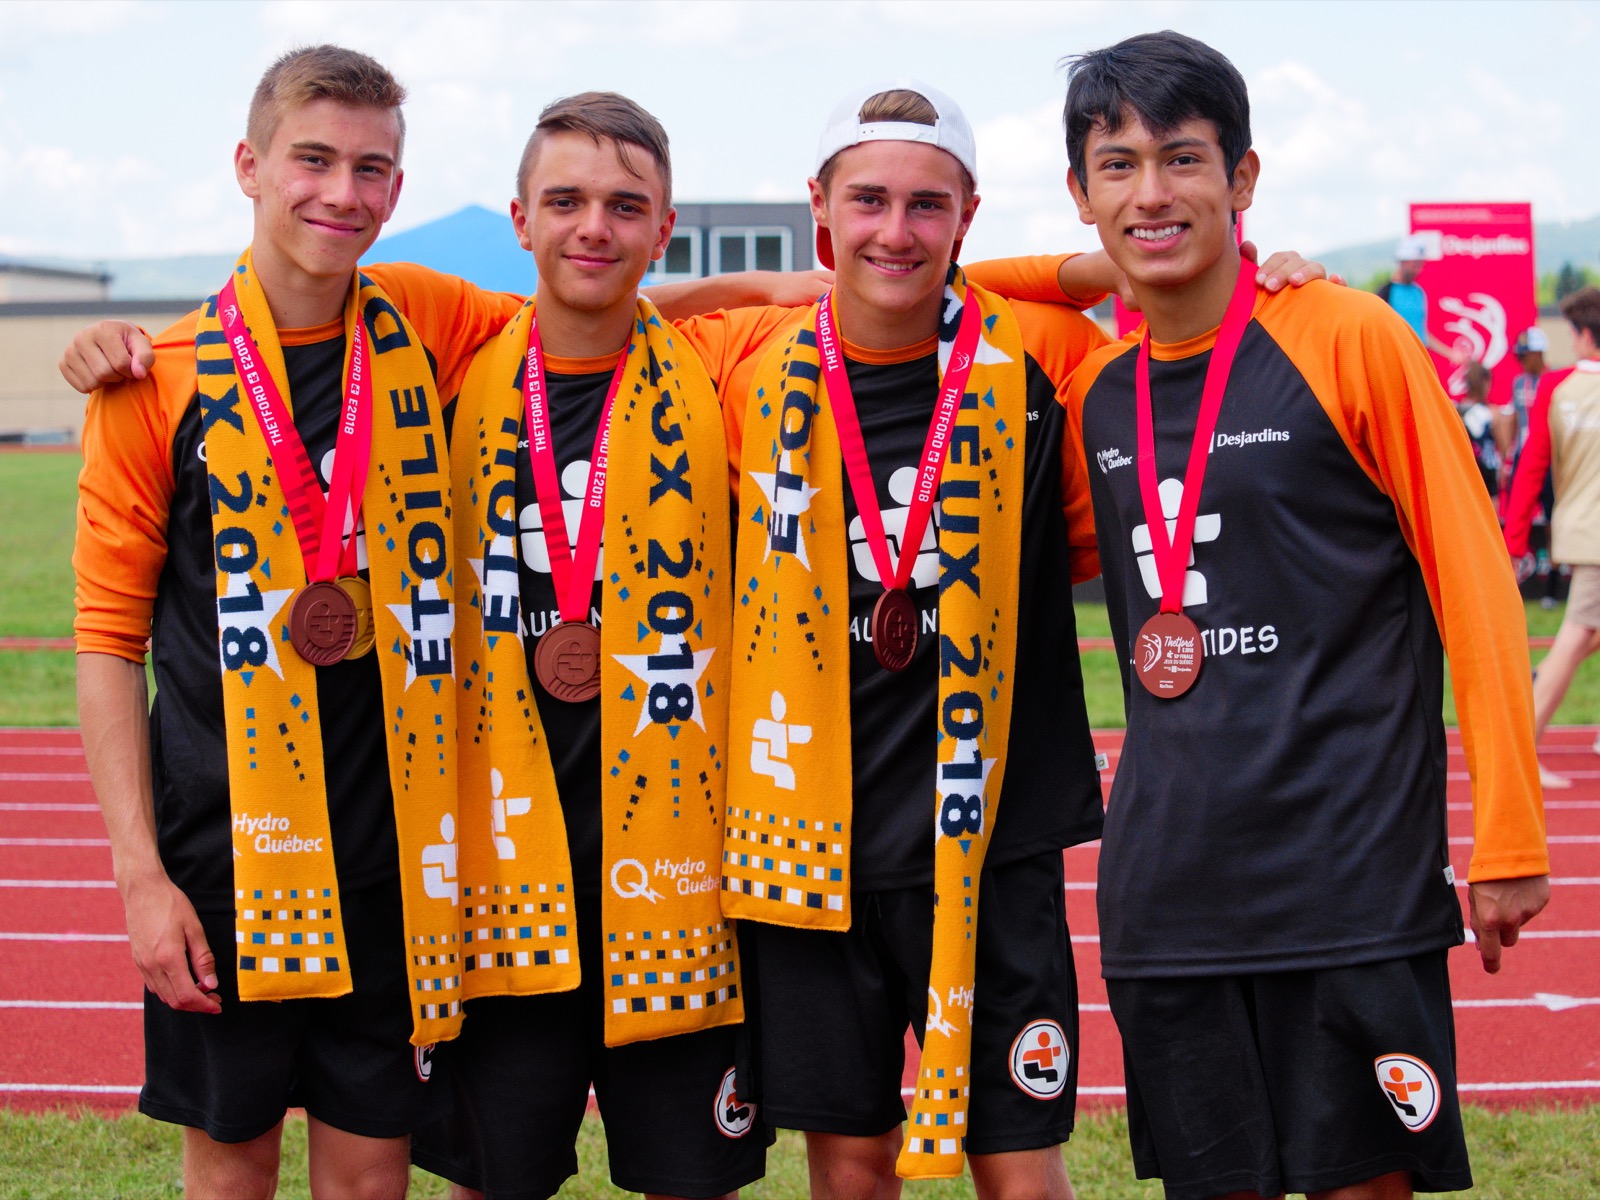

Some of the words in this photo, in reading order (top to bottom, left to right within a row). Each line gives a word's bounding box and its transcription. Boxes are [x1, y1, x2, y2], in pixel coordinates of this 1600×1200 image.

[233, 335, 254, 370] E2018
[353, 324, 362, 381] THETFORD
[818, 311, 838, 372] THETFORD
[528, 346, 539, 378] E2018
[252, 384, 283, 446] THETFORD
[344, 398, 358, 434] E2018
[531, 393, 546, 452] THETFORD
[931, 388, 958, 449] THETFORD
[1102, 447, 1120, 462] Hydro
[1216, 428, 1290, 448] Desjardins
[1108, 455, 1133, 470] Québec
[590, 471, 606, 508] E2018
[918, 465, 936, 502] E2018
[208, 470, 269, 671] 2018
[647, 538, 694, 724] 2018
[1164, 636, 1194, 653] Thetford
[940, 634, 984, 838] 2018
[233, 812, 290, 835] Hydro
[254, 833, 323, 853] Québec
[654, 857, 706, 879] Hydro
